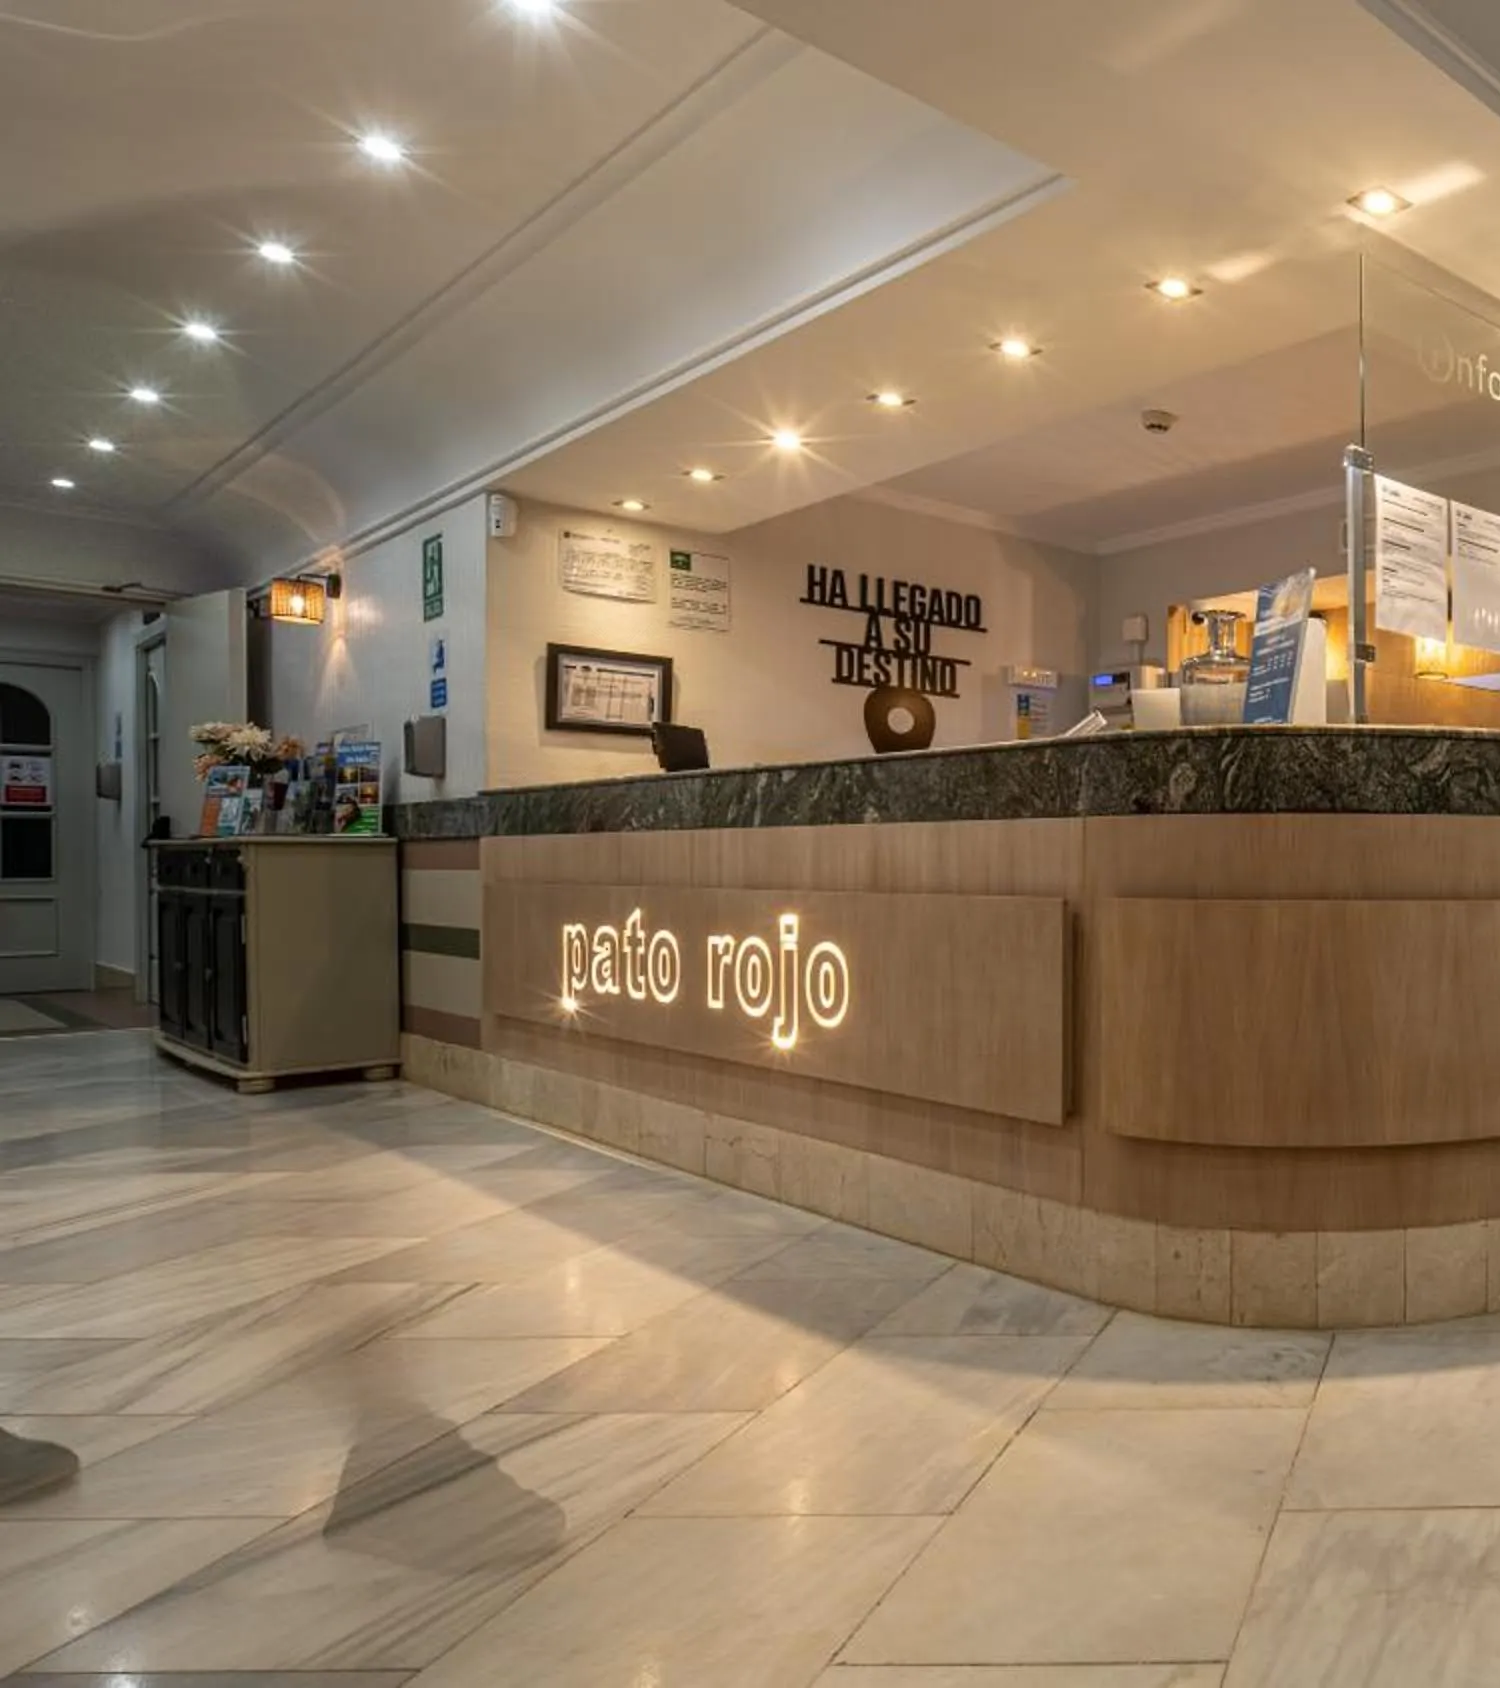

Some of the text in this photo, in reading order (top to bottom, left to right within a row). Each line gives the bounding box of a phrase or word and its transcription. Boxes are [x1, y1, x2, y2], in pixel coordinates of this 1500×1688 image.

[807, 564, 982, 629] HA LLEGADO
[863, 612, 932, 659] A SU
[835, 645, 957, 695] DESTINO
[562, 908, 849, 1049] pato rojo
